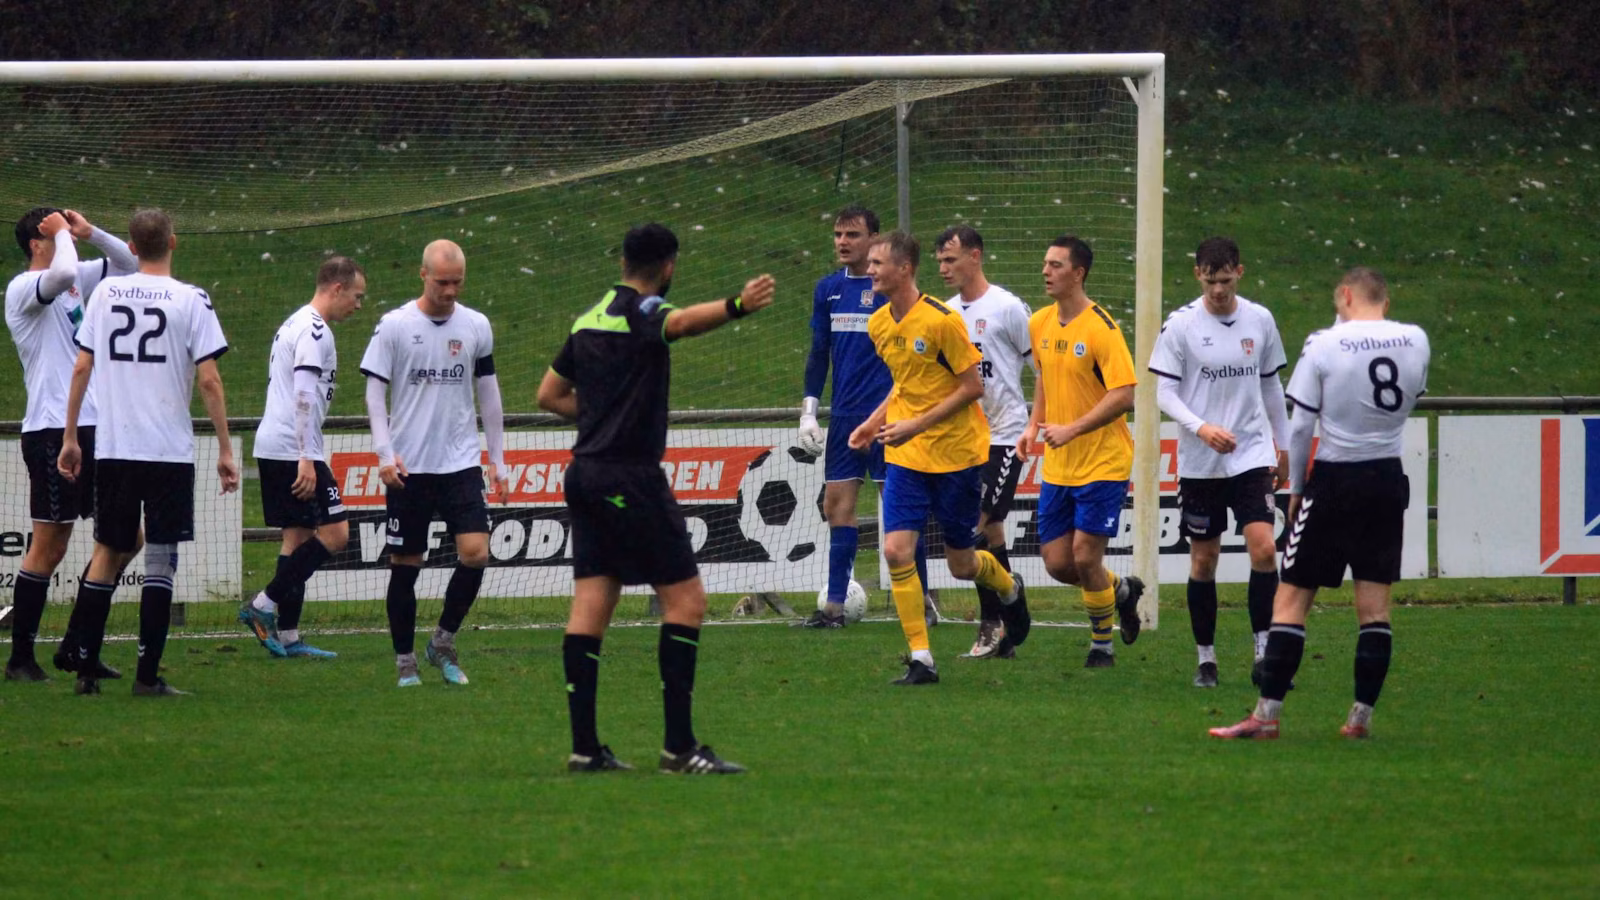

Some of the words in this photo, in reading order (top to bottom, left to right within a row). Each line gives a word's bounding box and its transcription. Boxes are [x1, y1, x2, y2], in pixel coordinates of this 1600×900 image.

[108, 286, 173, 301] Sydbank
[109, 305, 167, 363] 22
[1340, 335, 1414, 354] Sydbank
[1368, 356, 1404, 413] 8
